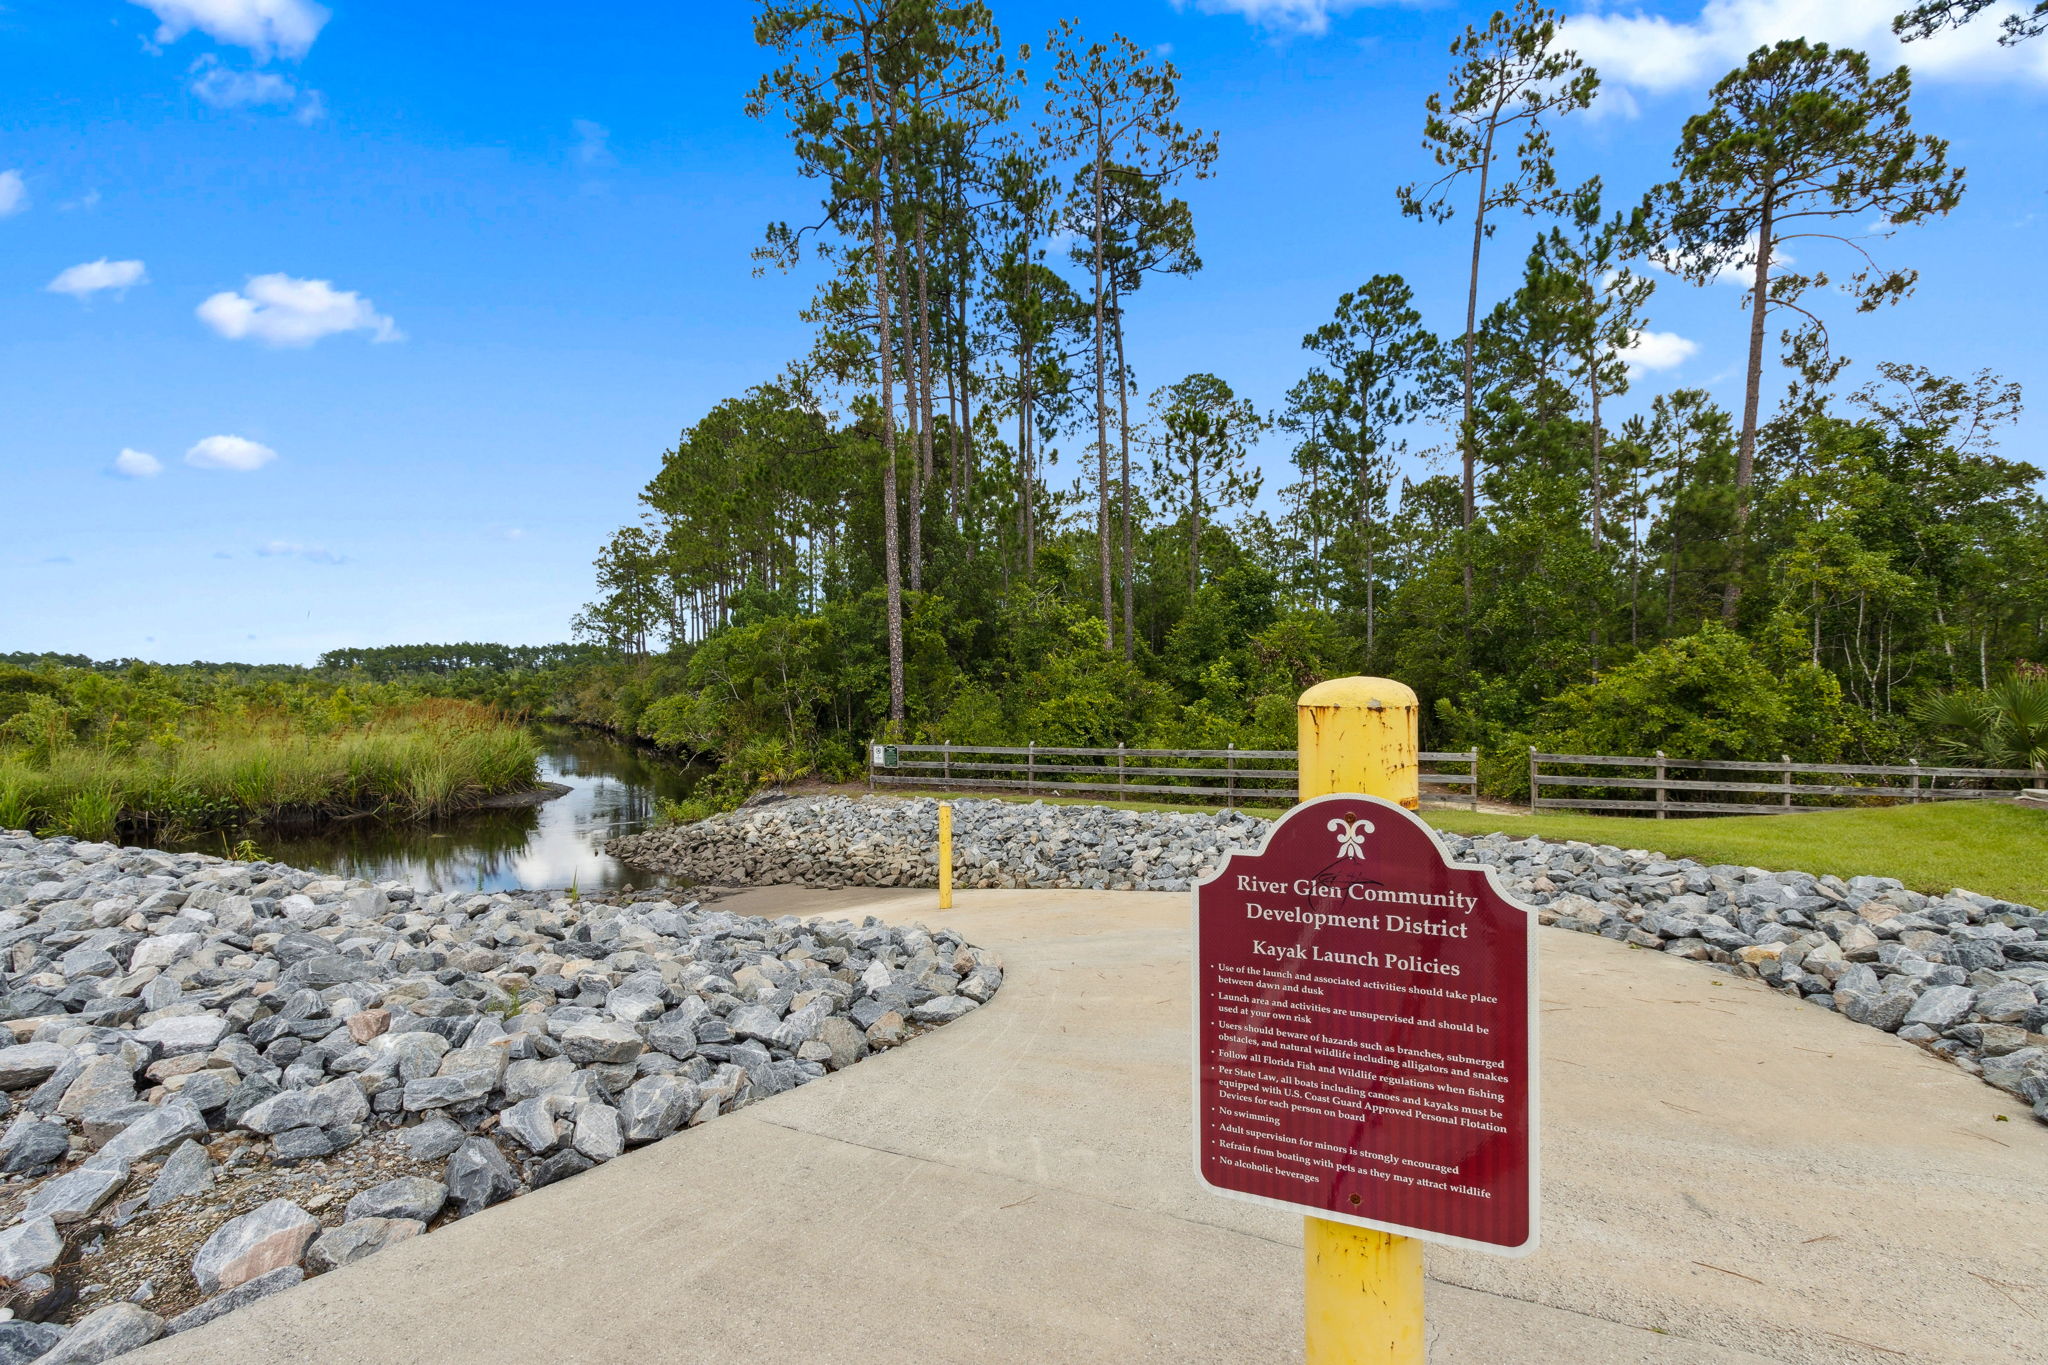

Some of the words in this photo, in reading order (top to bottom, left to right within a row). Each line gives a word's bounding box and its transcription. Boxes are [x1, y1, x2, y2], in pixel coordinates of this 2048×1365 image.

[1237, 875, 1288, 893] River
[1293, 879, 1341, 898] Glen
[1348, 884, 1477, 913] Community
[1247, 903, 1379, 929] Development
[1386, 915, 1467, 938] District
[1253, 940, 1307, 960] Kayak
[1313, 946, 1378, 966] Launch
[1385, 954, 1460, 975] Policies
[1218, 963, 1234, 972] Use
[1247, 967, 1260, 975] the
[1263, 968, 1292, 978] launch
[1294, 973, 1311, 981] and
[1313, 976, 1360, 986] associated
[1362, 981, 1406, 992] activities
[1408, 986, 1442, 996] should
[1445, 990, 1467, 999] take
[1470, 993, 1497, 1003] place
[1218, 975, 1253, 986] between
[1255, 980, 1280, 989] dawn
[1282, 984, 1298, 992] and
[1301, 985, 1323, 995] dusk
[1218, 992, 1249, 1002] Launch
[1290, 1002, 1330, 1013] activities
[1349, 1011, 1414, 1024] unsupervised
[1416, 1019, 1435, 1027] and
[1438, 1021, 1473, 1032] should
[1476, 1025, 1489, 1034] be
[1293, 1014, 1311, 1023] risk
[1218, 1033, 1259, 1046] obstacles,
[1261, 1040, 1277, 1048] and
[1280, 1043, 1311, 1053] natural
[1314, 1047, 1350, 1059] wildlife
[1353, 1052, 1399, 1068] including
[1401, 1060, 1448, 1073] alligators
[1472, 1072, 1508, 1082] snakes
[1219, 1020, 1242, 1030] Users
[1243, 1024, 1273, 1035] should
[1276, 1028, 1308, 1040] beware
[1322, 1034, 1357, 1047] hazards
[1360, 1042, 1382, 1050] such
[1397, 1045, 1444, 1060] branches,
[1446, 1054, 1504, 1069] submerged
[1218, 1049, 1247, 1059] Follow
[1250, 1054, 1261, 1062] all
[1263, 1056, 1294, 1067] Florida
[1297, 1061, 1315, 1070] Fish
[1338, 1067, 1376, 1080] Wildlife
[1379, 1076, 1434, 1089] regulations
[1436, 1084, 1465, 1094] when
[1468, 1087, 1504, 1103] fishing
[1219, 1065, 1232, 1074] Per
[1234, 1068, 1255, 1078] State
[1258, 1071, 1278, 1083] Law,
[1280, 1076, 1291, 1084] all
[1294, 1077, 1318, 1088] boats
[1320, 1082, 1366, 1099] including
[1367, 1092, 1400, 1101] canoes
[1402, 1097, 1421, 1105] and
[1423, 1098, 1458, 1111] kayaks
[1461, 1107, 1487, 1116] must
[1489, 1109, 1502, 1118] be
[1218, 1080, 1259, 1091] equipped
[1261, 1086, 1281, 1094] with
[1284, 1088, 1302, 1098] U.S.
[1304, 1092, 1329, 1103] Coast
[1332, 1096, 1361, 1108] Guard
[1364, 1102, 1412, 1116] Approved
[1415, 1110, 1457, 1124] Personal
[1460, 1118, 1507, 1133] Flotation
[1219, 1090, 1252, 1102] Devices
[1254, 1095, 1267, 1104] for
[1269, 1100, 1288, 1108] each
[1291, 1104, 1321, 1114] person
[1338, 1110, 1365, 1122] board
[1219, 1106, 1232, 1115] No
[1233, 1111, 1280, 1126] swimming
[1219, 1123, 1243, 1134] Adult
[1245, 1130, 1296, 1143] supervision
[1299, 1137, 1312, 1146] for
[1314, 1142, 1347, 1153] minors
[1349, 1146, 1357, 1155] is
[1359, 1150, 1399, 1165] strongly
[1401, 1159, 1458, 1174] encouraged
[1219, 1139, 1250, 1152] Refrain
[1253, 1146, 1274, 1156] from
[1276, 1150, 1310, 1165] boating
[1312, 1158, 1333, 1168] with
[1336, 1164, 1355, 1172] pets
[1370, 1168, 1390, 1181] they
[1393, 1175, 1414, 1185] may
[1416, 1179, 1446, 1190] attract
[1449, 1185, 1490, 1198] wildlife
[1219, 1156, 1232, 1165] No
[1234, 1160, 1273, 1173] alcoholic
[1275, 1167, 1319, 1182] beverages
